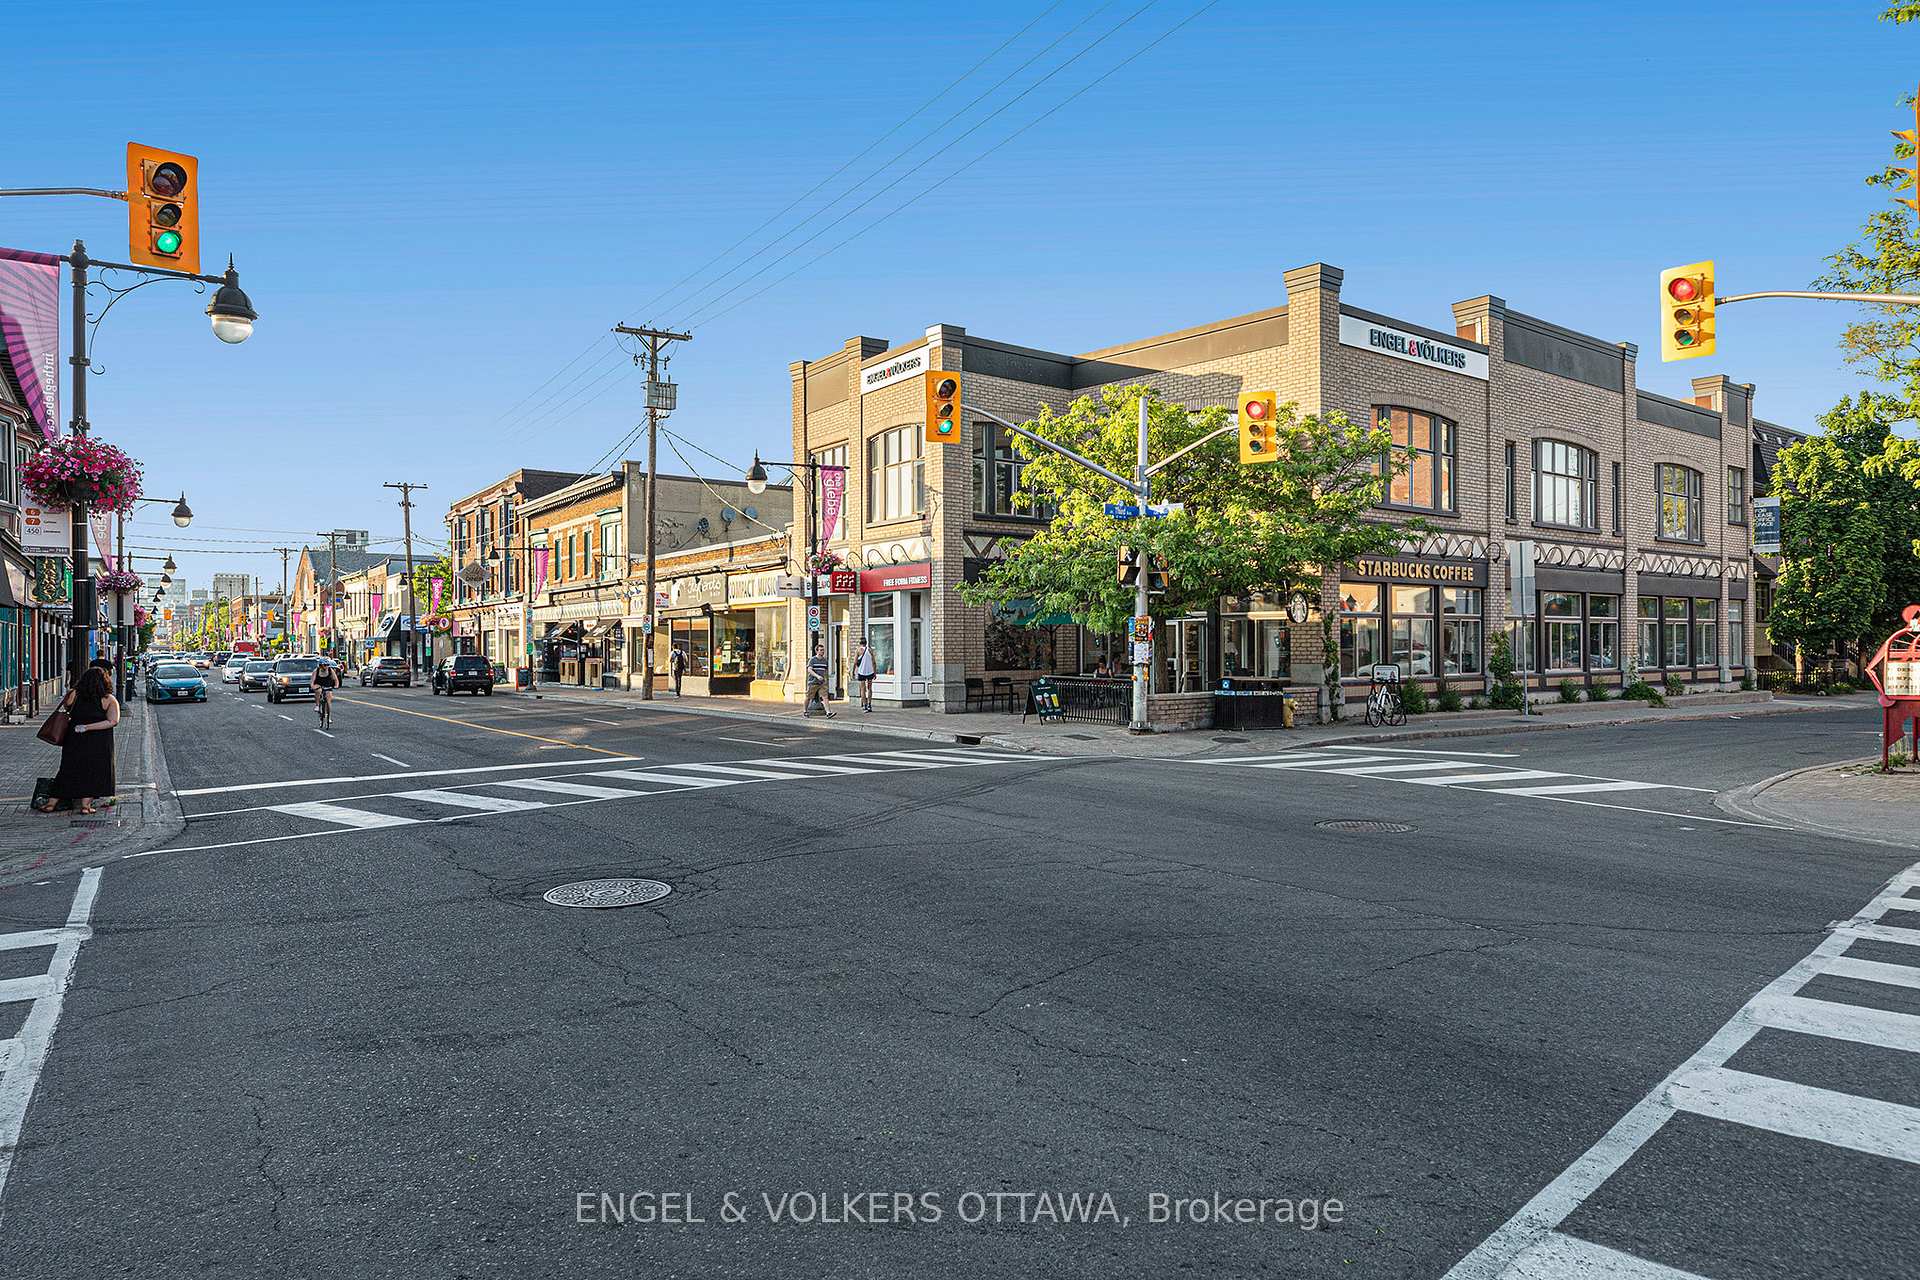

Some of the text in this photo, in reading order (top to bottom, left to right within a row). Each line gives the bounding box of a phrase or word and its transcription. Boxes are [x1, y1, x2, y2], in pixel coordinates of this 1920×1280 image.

[823, 479, 838, 515] glebe
[883, 579, 895, 587] FREE
[908, 575, 928, 585] FITNESS
[1358, 559, 1474, 581] STARBUCKS COFFEE
